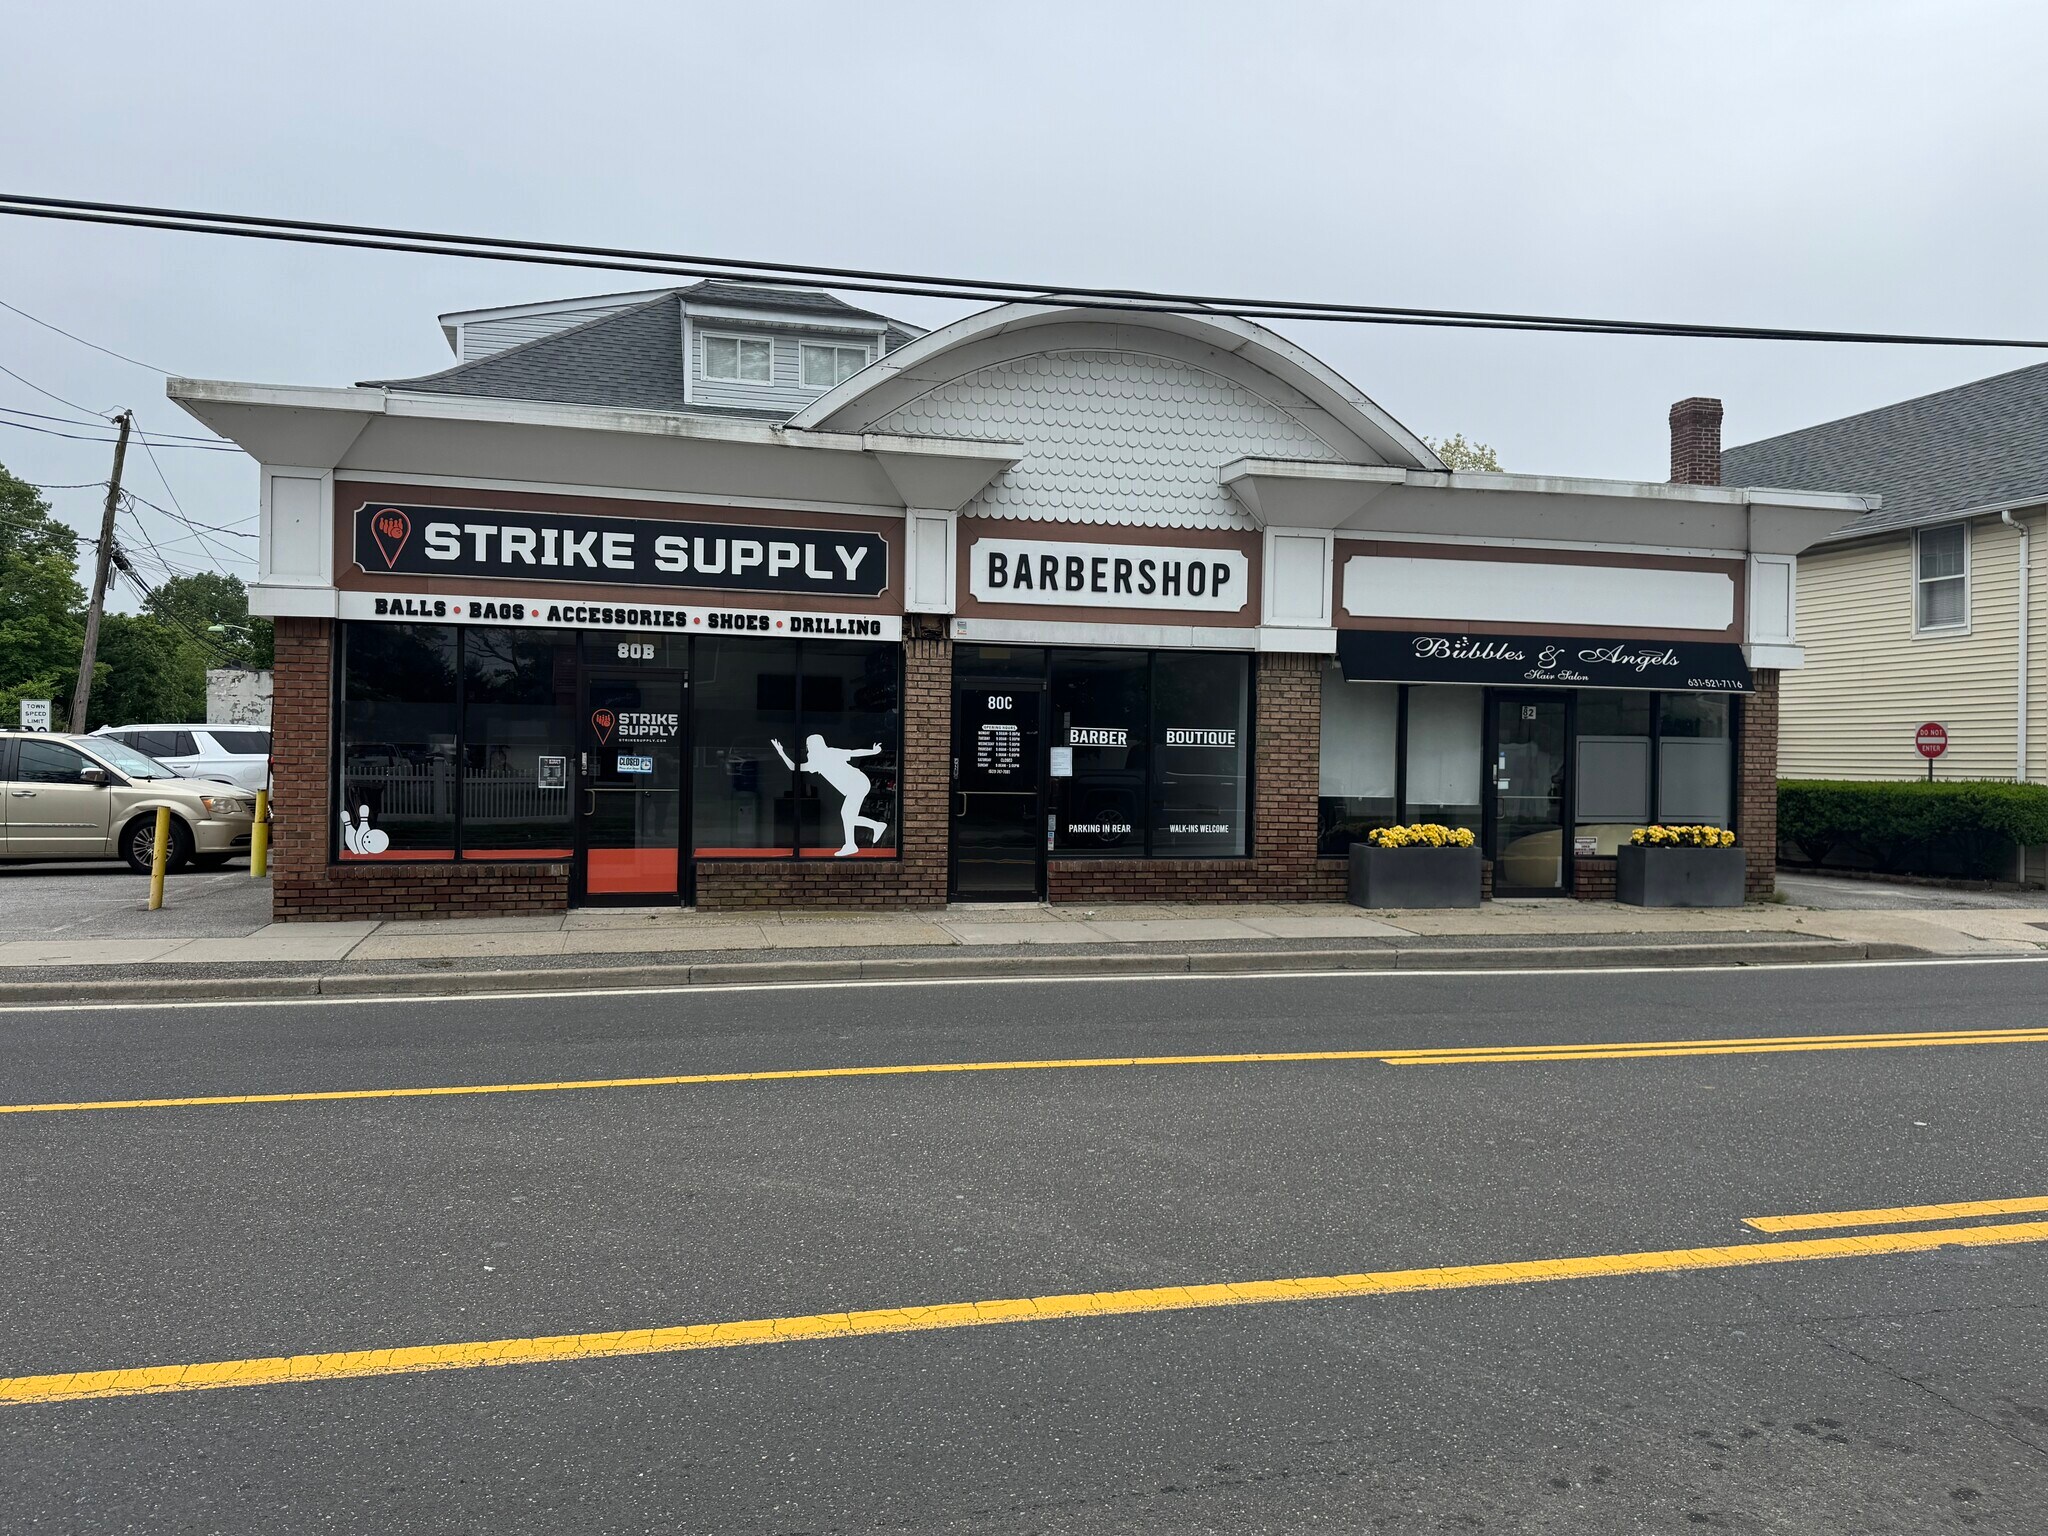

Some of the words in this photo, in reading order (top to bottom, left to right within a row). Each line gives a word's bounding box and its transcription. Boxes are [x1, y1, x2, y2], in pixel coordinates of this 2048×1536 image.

[424, 522, 635, 570] STRIKE
[654, 534, 868, 581] SUPPLY
[988, 552, 1231, 597] BARBERSHOP
[375, 598, 446, 617] BALLS
[469, 602, 525, 620] BAGS
[547, 606, 687, 627] ACCESSORIES
[708, 613, 770, 631] SHOES
[790, 617, 881, 636] DRILLING
[617, 643, 655, 659] 80B
[1412, 636, 1525, 660] Bubbles
[1537, 645, 1565, 669] &
[1578, 644, 1680, 673] Angels
[1524, 669, 1555, 680] Hair
[1557, 669, 1589, 682] Salon
[1687, 678, 1743, 689] 631-521-7116
[988, 696, 1013, 710] 80C
[618, 713, 678, 725] STRIKE
[618, 725, 678, 736] SUPPLY
[1070, 730, 1127, 745] BARBER
[1166, 731, 1236, 745] BOUTIQUE
[619, 757, 640, 766] CLOSED
[1069, 824, 1100, 833] PARKING
[1102, 824, 1110, 833] IN
[1112, 824, 1131, 833] REAR
[1170, 824, 1199, 833] WALK-INS
[1200, 824, 1229, 833] WELCOME
